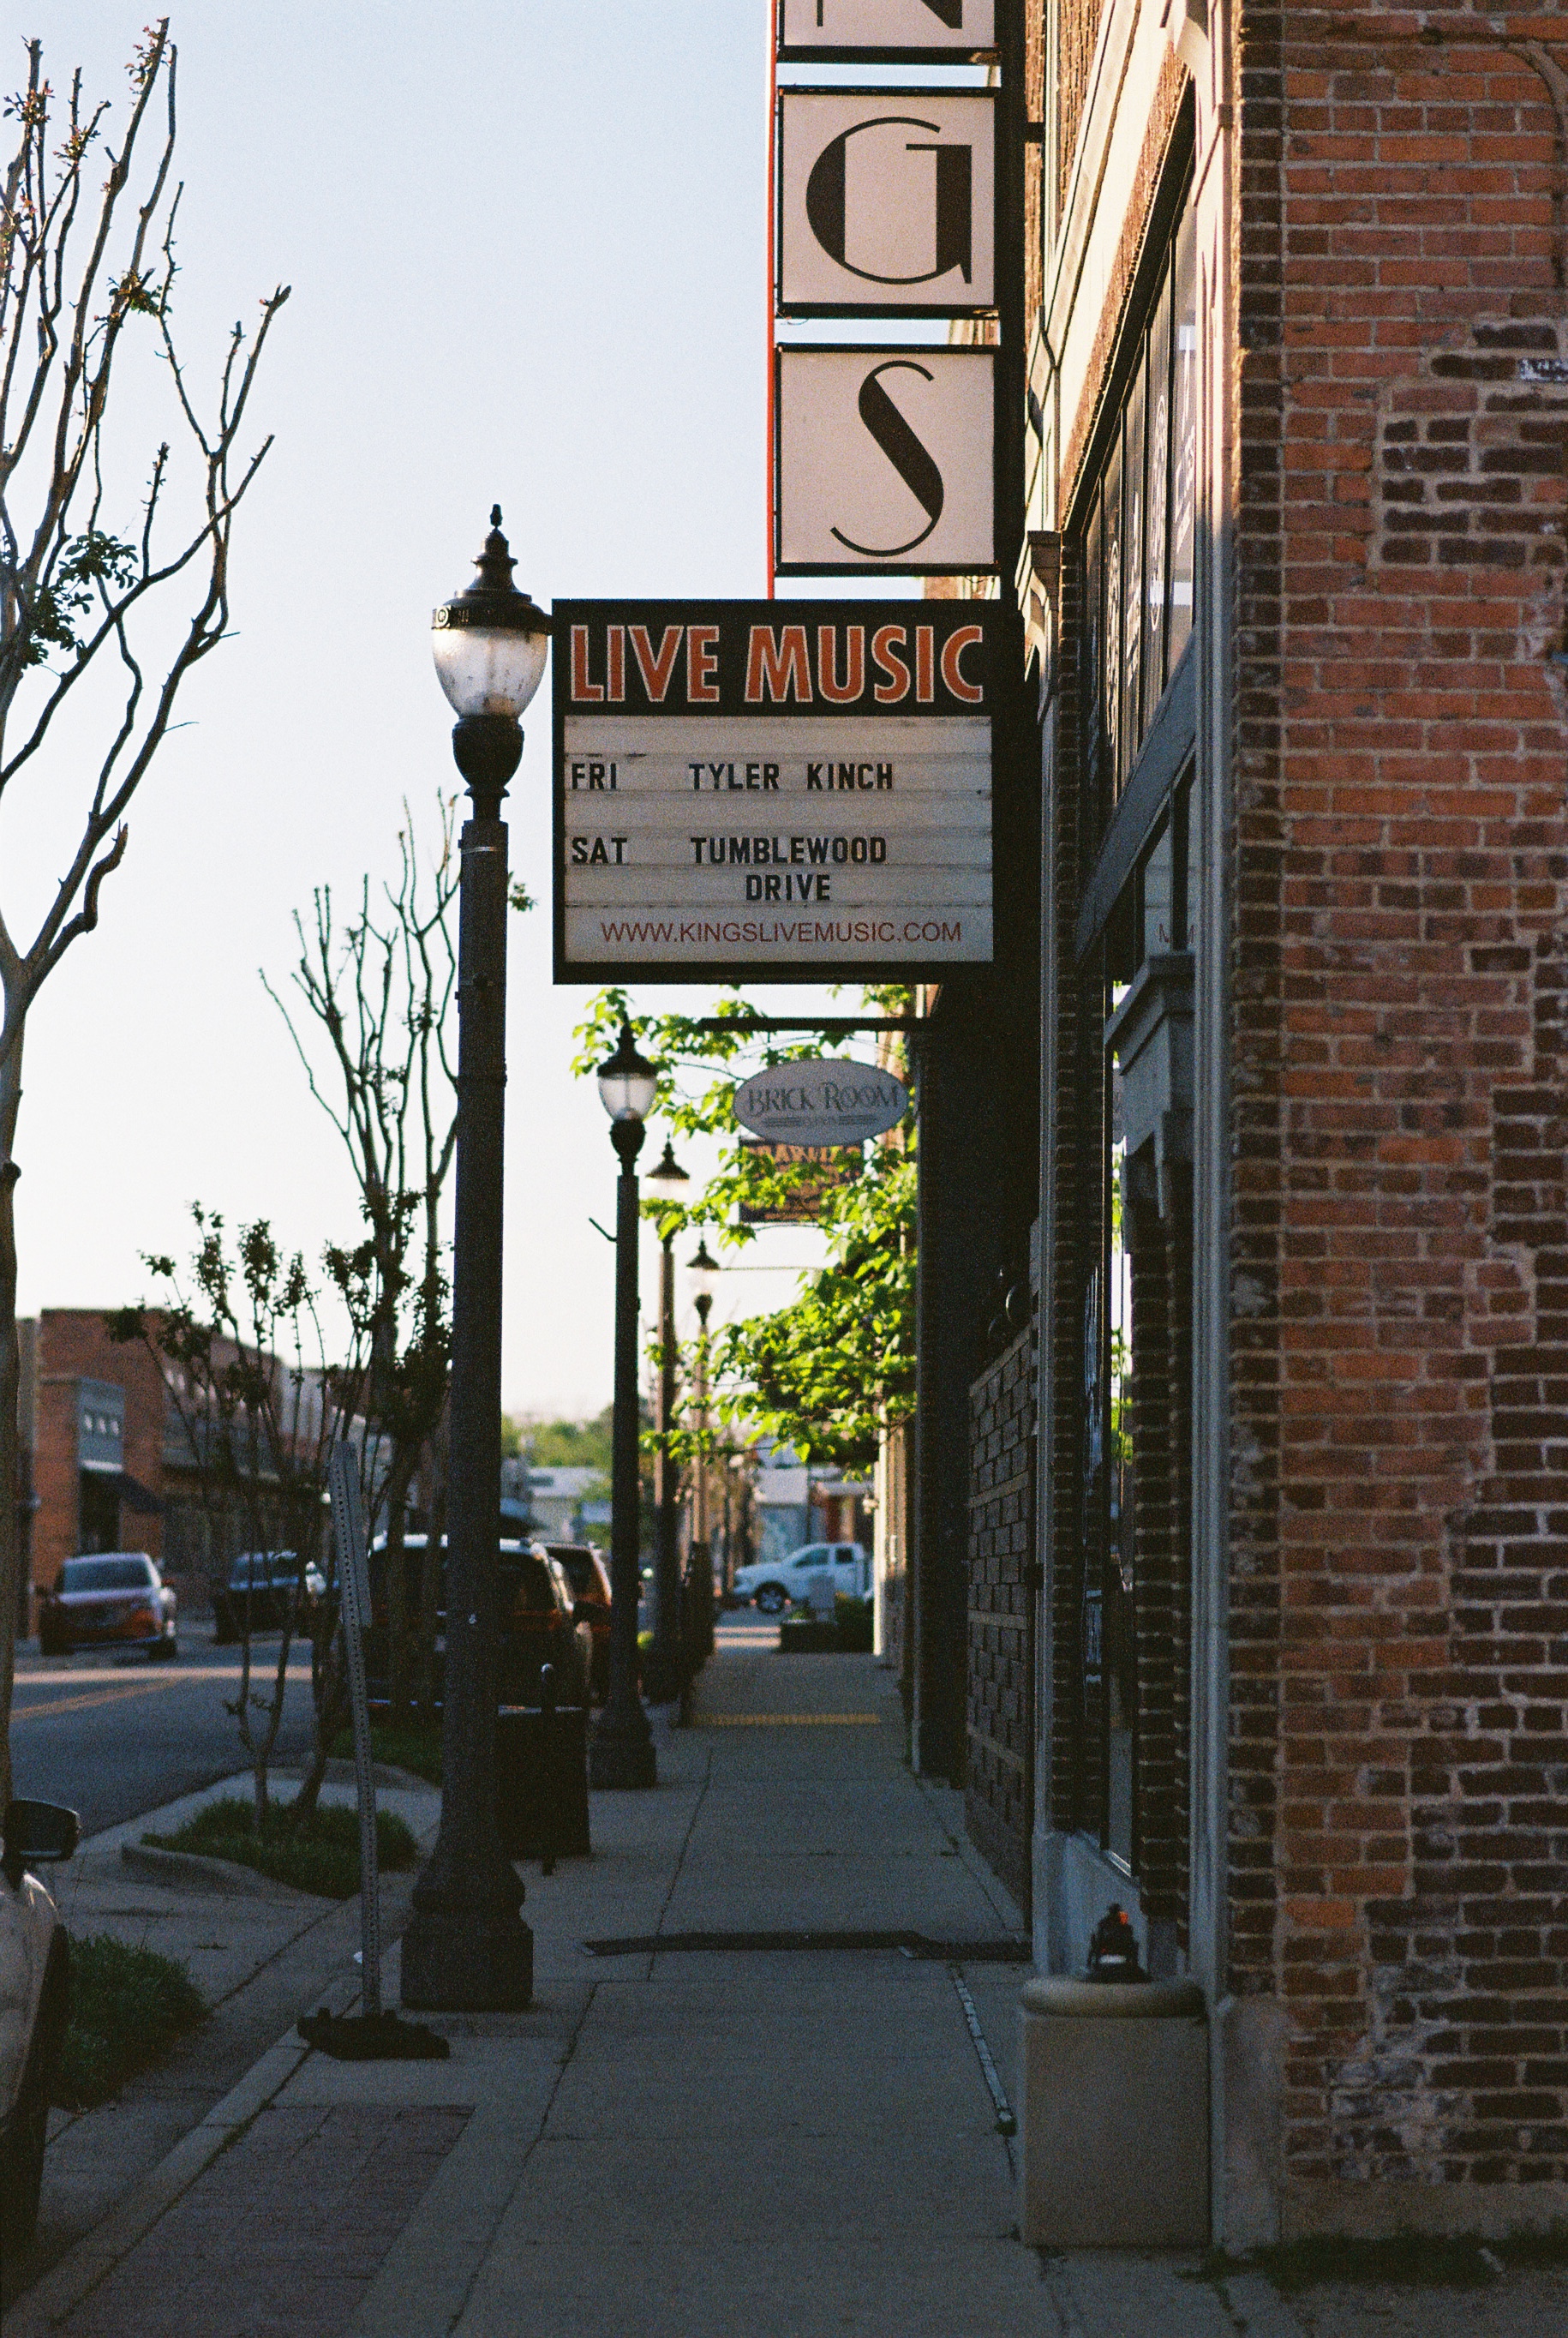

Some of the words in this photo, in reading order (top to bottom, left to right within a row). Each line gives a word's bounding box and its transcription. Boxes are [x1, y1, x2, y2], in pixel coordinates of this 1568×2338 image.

[805, 0, 973, 558] GS
[570, 625, 720, 704] LIVE
[744, 625, 984, 704] MUSIC
[571, 764, 617, 789] FRI
[688, 764, 779, 789] TYLER
[806, 764, 893, 789] KINCH
[571, 837, 627, 864] SAT
[690, 837, 888, 864] TUMBLEWOOD
[745, 874, 831, 901] DRIVE
[601, 922, 962, 943] WWW.KINGSLIVEMUSIC.COM
[748, 1086, 814, 1117] BRICK
[821, 1082, 900, 1112] ROOM
